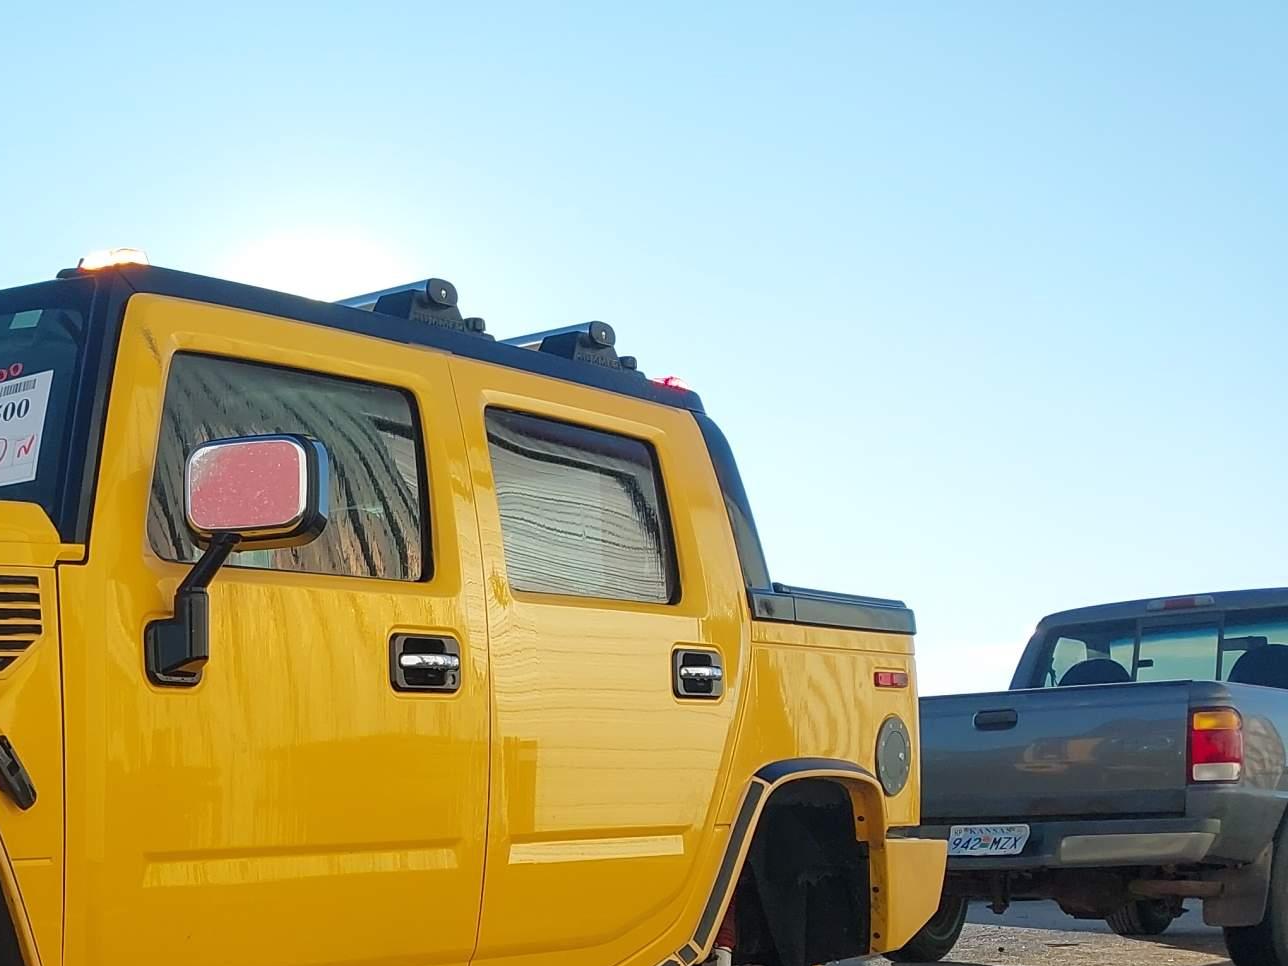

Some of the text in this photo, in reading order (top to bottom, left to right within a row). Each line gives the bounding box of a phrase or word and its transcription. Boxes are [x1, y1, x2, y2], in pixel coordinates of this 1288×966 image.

[969, 827, 1012, 835] KANSAS
[951, 836, 1022, 851] 942 MZX
